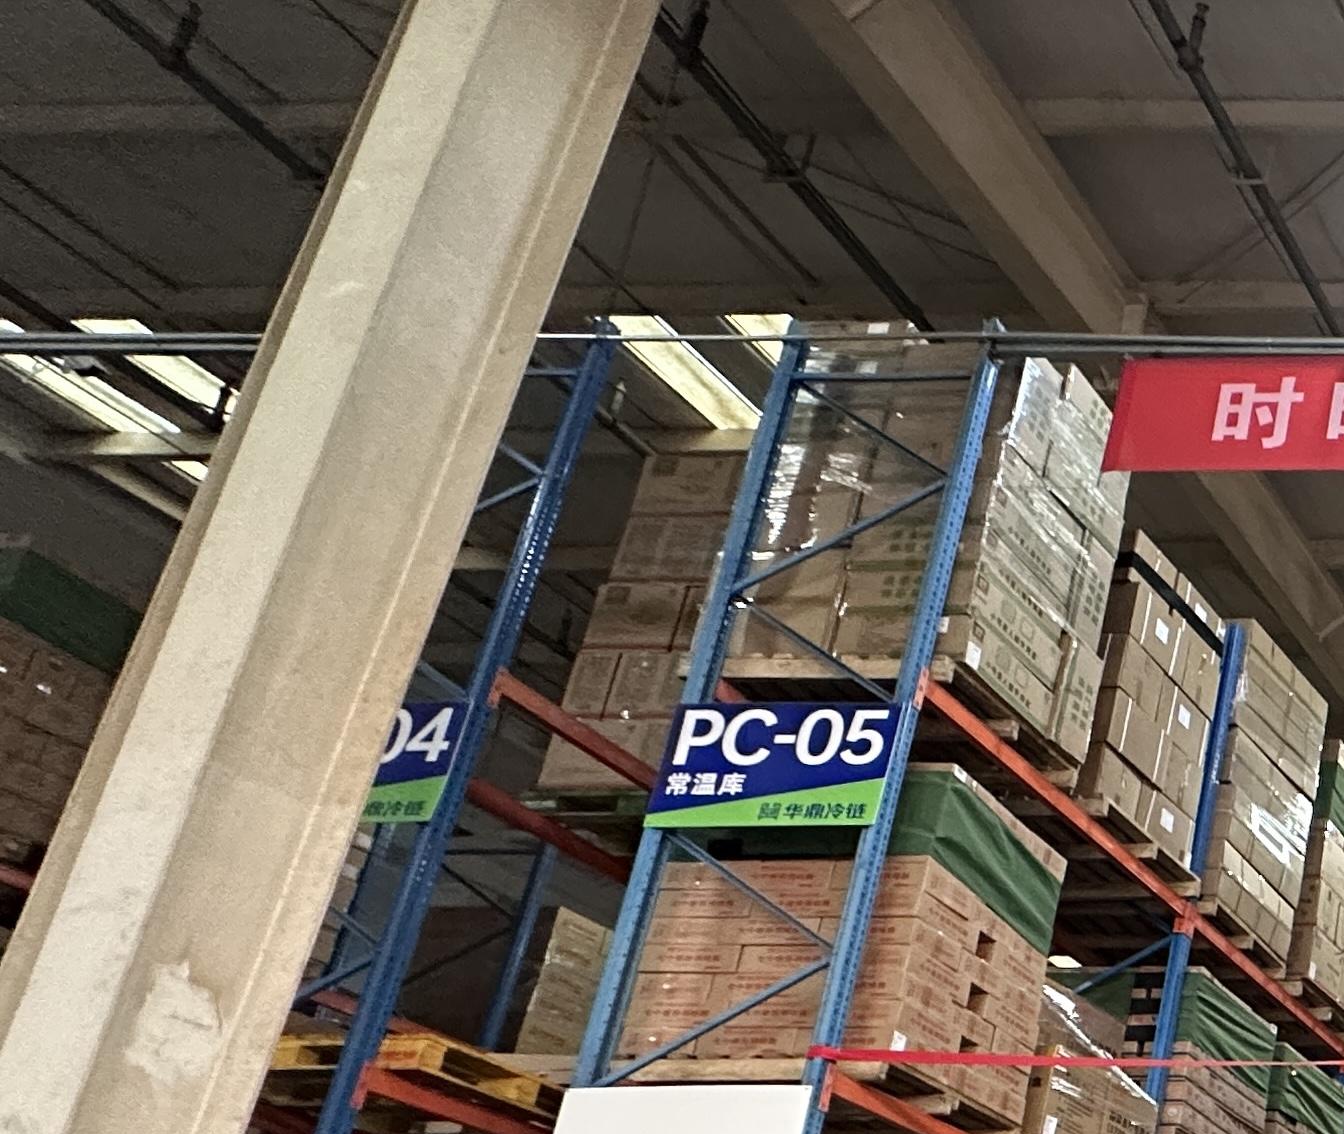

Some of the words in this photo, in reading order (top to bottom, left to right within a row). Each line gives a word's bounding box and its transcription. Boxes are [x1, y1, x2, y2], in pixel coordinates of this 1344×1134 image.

[671, 708, 891, 766] PC-05
[664, 773, 746, 797] 常温库
[782, 802, 868, 821] 华鼎冷链
